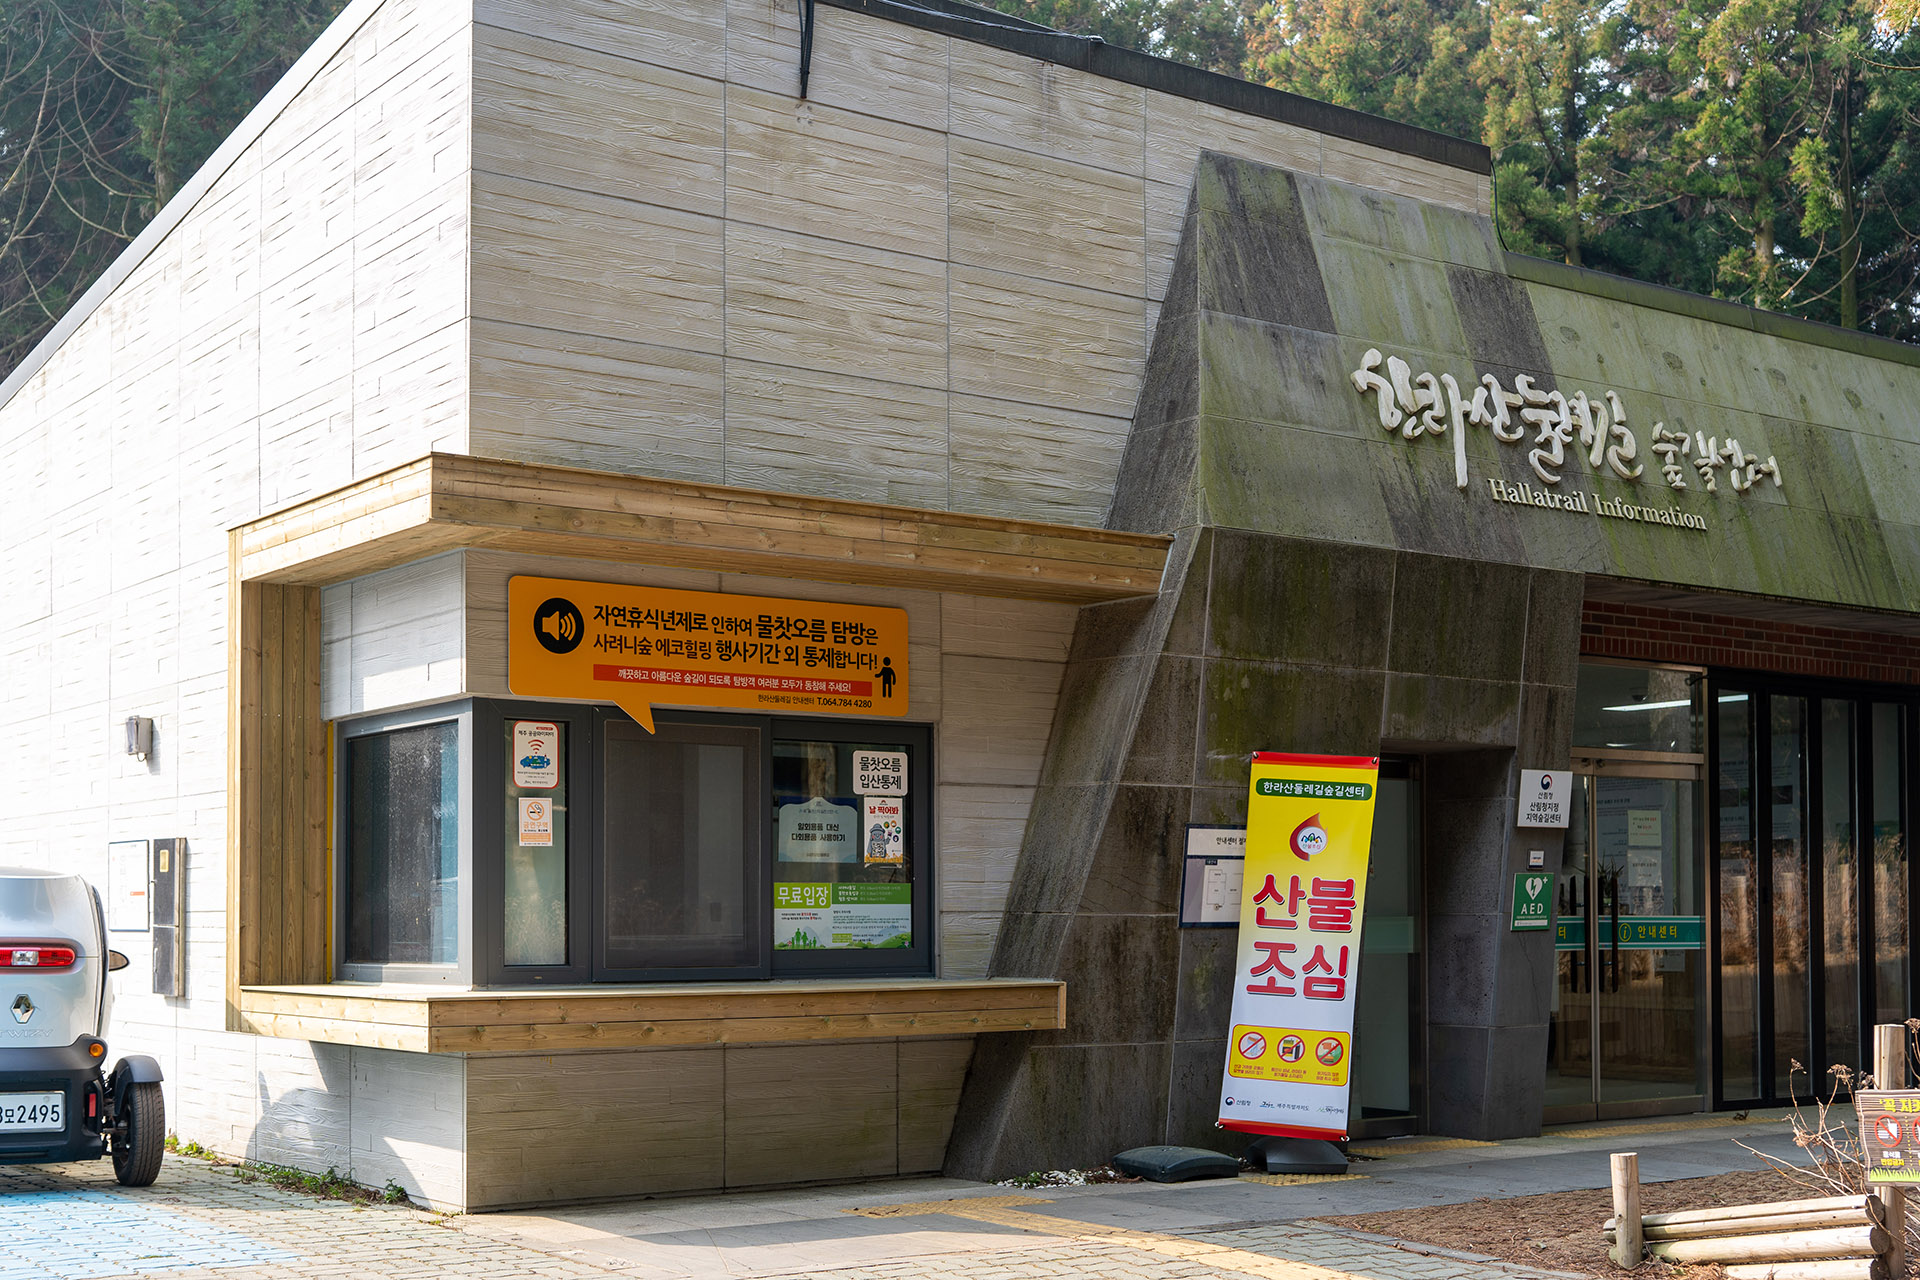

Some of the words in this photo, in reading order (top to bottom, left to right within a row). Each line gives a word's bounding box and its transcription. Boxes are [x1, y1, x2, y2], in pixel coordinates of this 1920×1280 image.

[1488, 478, 1590, 514] Hallatrail
[1591, 493, 1707, 532] Information
[593, 604, 709, 632] 자연휴식년제로
[711, 616, 753, 636] 인하여
[755, 614, 828, 643] 물찻오름
[831, 621, 879, 646] 탐방은
[593, 633, 653, 656] 사려니숲
[655, 638, 712, 660] 에코힐링
[715, 639, 781, 665] 행사기간
[783, 645, 799, 667] 외
[802, 645, 878, 671] 통제합니다!
[618, 668, 649, 680] 깨끗하고
[651, 670, 682, 683] 아름다운
[683, 673, 707, 684] 숲길이
[708, 674, 731, 686] 되도록
[733, 676, 756, 687] 탐방객
[757, 678, 779, 688] 여러분
[781, 679, 803, 690] 모두가
[804, 681, 827, 691] 동참해
[828, 682, 851, 693] 주세요!
[758, 694, 792, 704] 한라산둘레길
[792, 696, 815, 705] 안내센터
[816, 697, 852, 708] T.064.784
[853, 699, 873, 708] 4280
[859, 756, 902, 773] 물찻오름
[859, 773, 902, 790] 입산통제
[1263, 781, 1366, 798] 한라산둘레길숲길센터
[1537, 791, 1554, 800] 산림청
[1529, 801, 1560, 813] 산림청지정
[1525, 812, 1562, 824] 지역숲길센터
[819, 833, 846, 842] 사용하기
[777, 886, 829, 906] 무료입장
[1252, 873, 1357, 934] 산불
[1520, 902, 1544, 915] AED
[1637, 923, 1678, 939] 안내센터
[1245, 940, 1350, 1001] 조심
[0, 1028, 53, 1038] WIZY
[1277, 1103, 1310, 1112] 제주특별자치도
